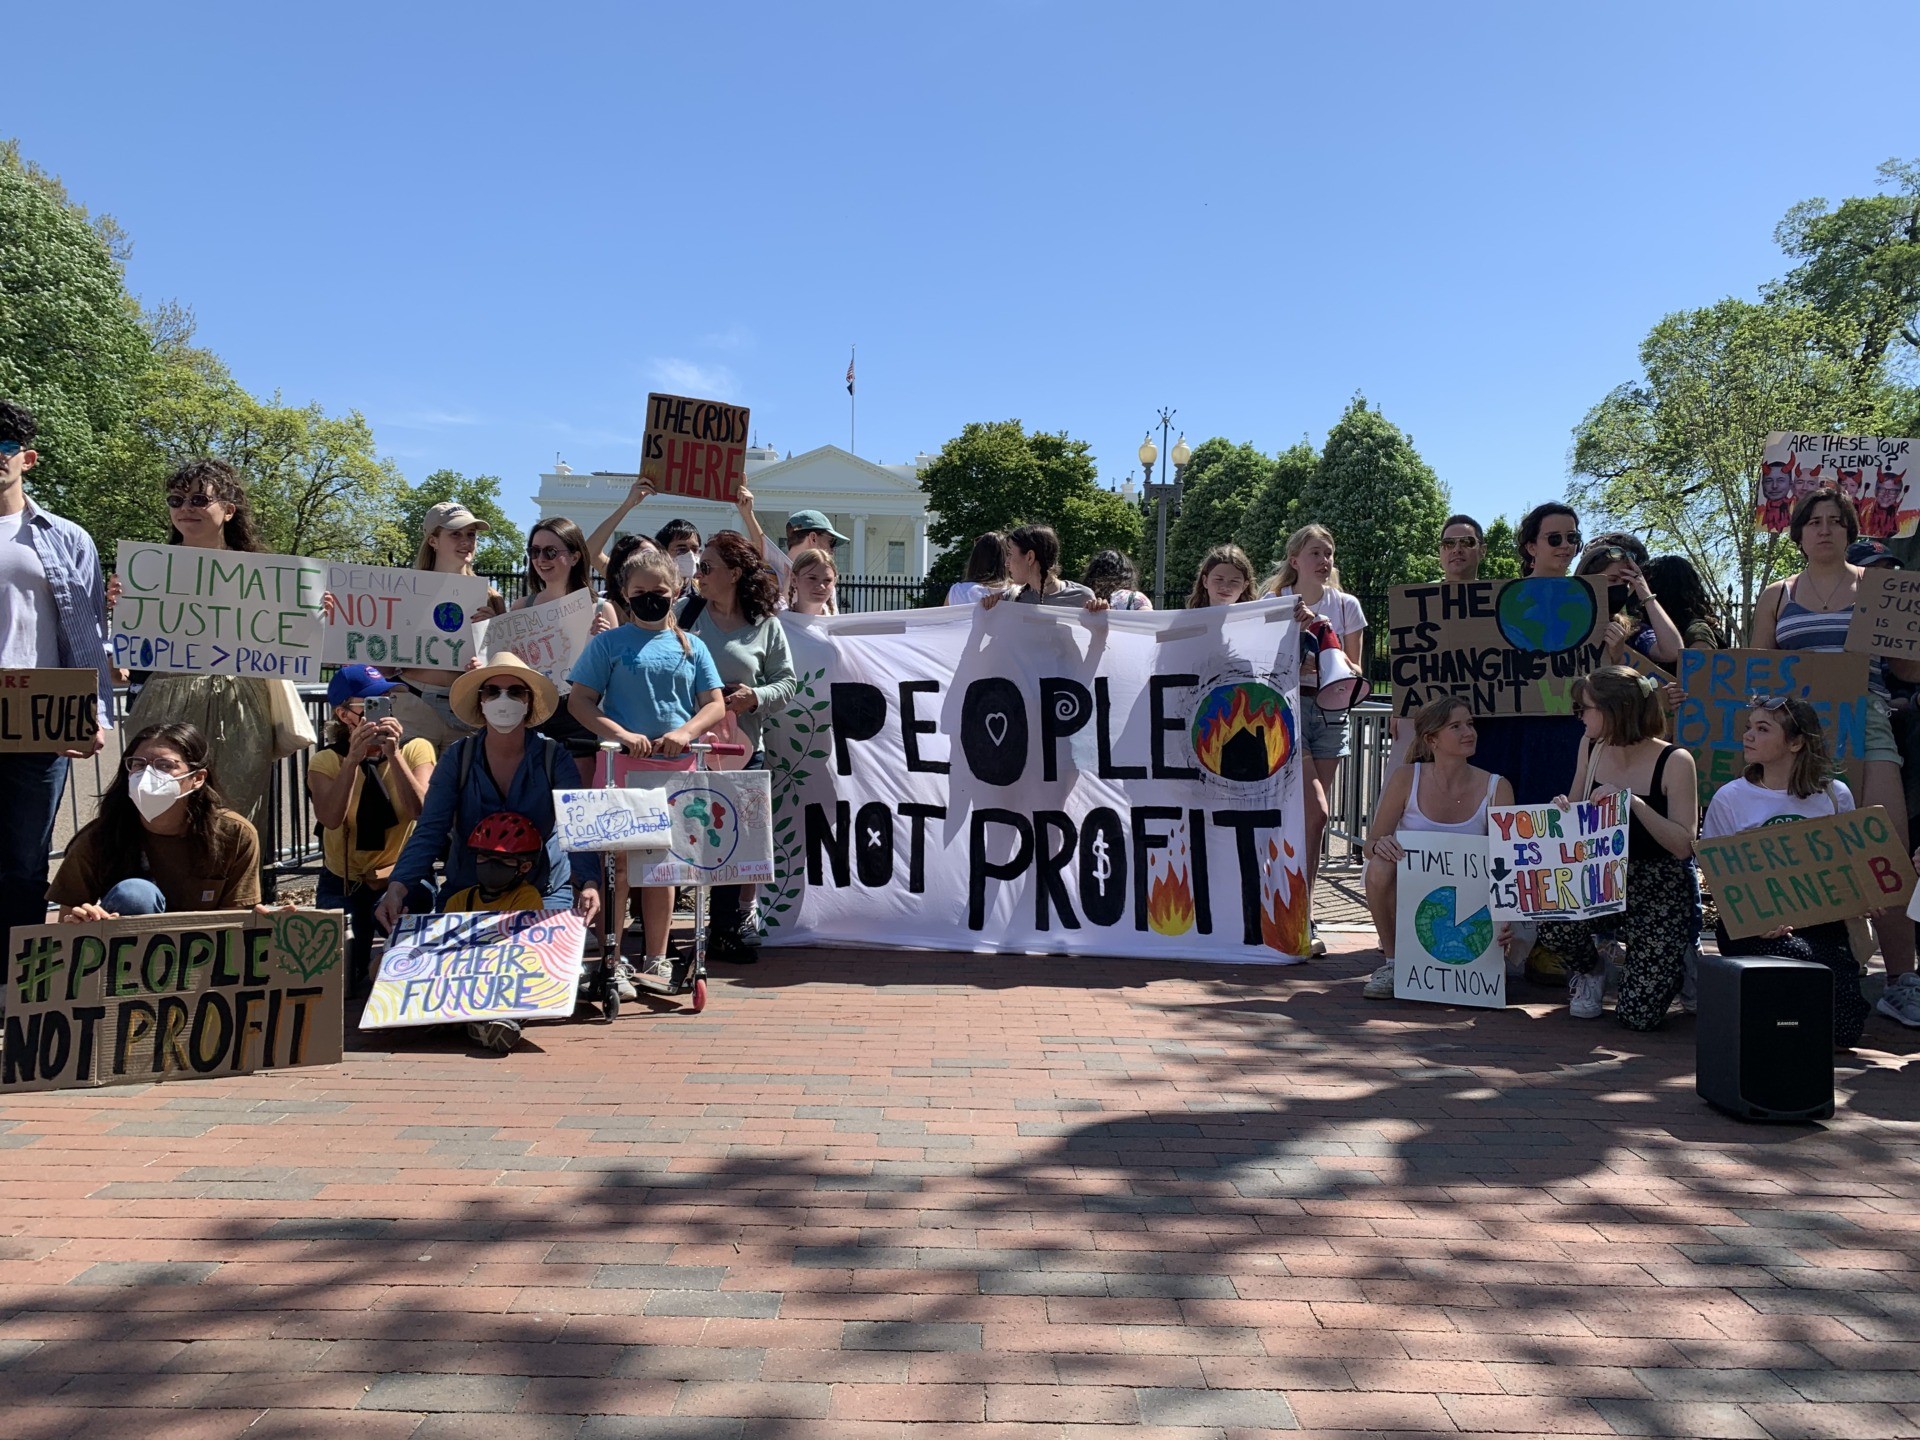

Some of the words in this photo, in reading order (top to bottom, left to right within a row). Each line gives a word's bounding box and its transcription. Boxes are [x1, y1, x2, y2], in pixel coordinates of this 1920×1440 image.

[651, 396, 693, 434] THE
[693, 403, 748, 443] CRISIS
[1787, 435, 1818, 452] ARE
[1822, 435, 1870, 452] THESE
[1876, 434, 1910, 455] YOUR
[645, 434, 663, 459] IS
[664, 438, 743, 503] HERE
[128, 549, 323, 609] CLIMATE
[329, 567, 432, 597] DENIAL
[121, 596, 309, 648] JUSTICE
[328, 593, 402, 630] NOT
[1405, 583, 1496, 622] THE
[1875, 618, 1889, 628] IS
[346, 631, 466, 667] POLICY
[479, 611, 543, 650] SYSTEM
[511, 633, 555, 666] NOT
[1390, 621, 1441, 655] IS
[113, 633, 202, 670] PEOPLE
[236, 647, 312, 676] PROFIT
[1392, 647, 1547, 687] CHANGING
[1550, 641, 1605, 678] WHY
[0, 675, 31, 688] RE
[1537, 678, 1574, 714] W
[31, 692, 99, 741] FUELS
[830, 673, 1203, 786] PEOPLE
[1677, 696, 1868, 760] BIN
[1491, 808, 1564, 841] YOUR
[1577, 789, 1629, 836] MOTHER
[1403, 849, 1455, 876] TIME
[1464, 853, 1478, 878] IS
[1514, 841, 1542, 866] IS
[1560, 836, 1610, 864] LOSING
[1700, 834, 1801, 877] THERE
[1804, 828, 1834, 862] IS
[1834, 815, 1890, 851] NO
[651, 864, 676, 882] WHAT
[710, 869, 724, 882] WE
[725, 865, 739, 882] DO
[805, 801, 947, 894] NOT
[968, 805, 1282, 946] PROFIT
[1517, 867, 1580, 912] HER
[1581, 857, 1627, 907] COLORS
[1723, 864, 1862, 924] PLANET
[1867, 856, 1903, 894] B
[391, 911, 501, 948] HERE
[509, 910, 566, 945] for
[15, 928, 274, 1004] #PEOPLE
[428, 944, 528, 977] THEIR
[1407, 965, 1453, 992] ACT
[1455, 968, 1501, 996] NOW
[399, 972, 545, 1015] FUTURE
[1, 1006, 106, 1084] NOT
[113, 986, 326, 1075] PROFIT
